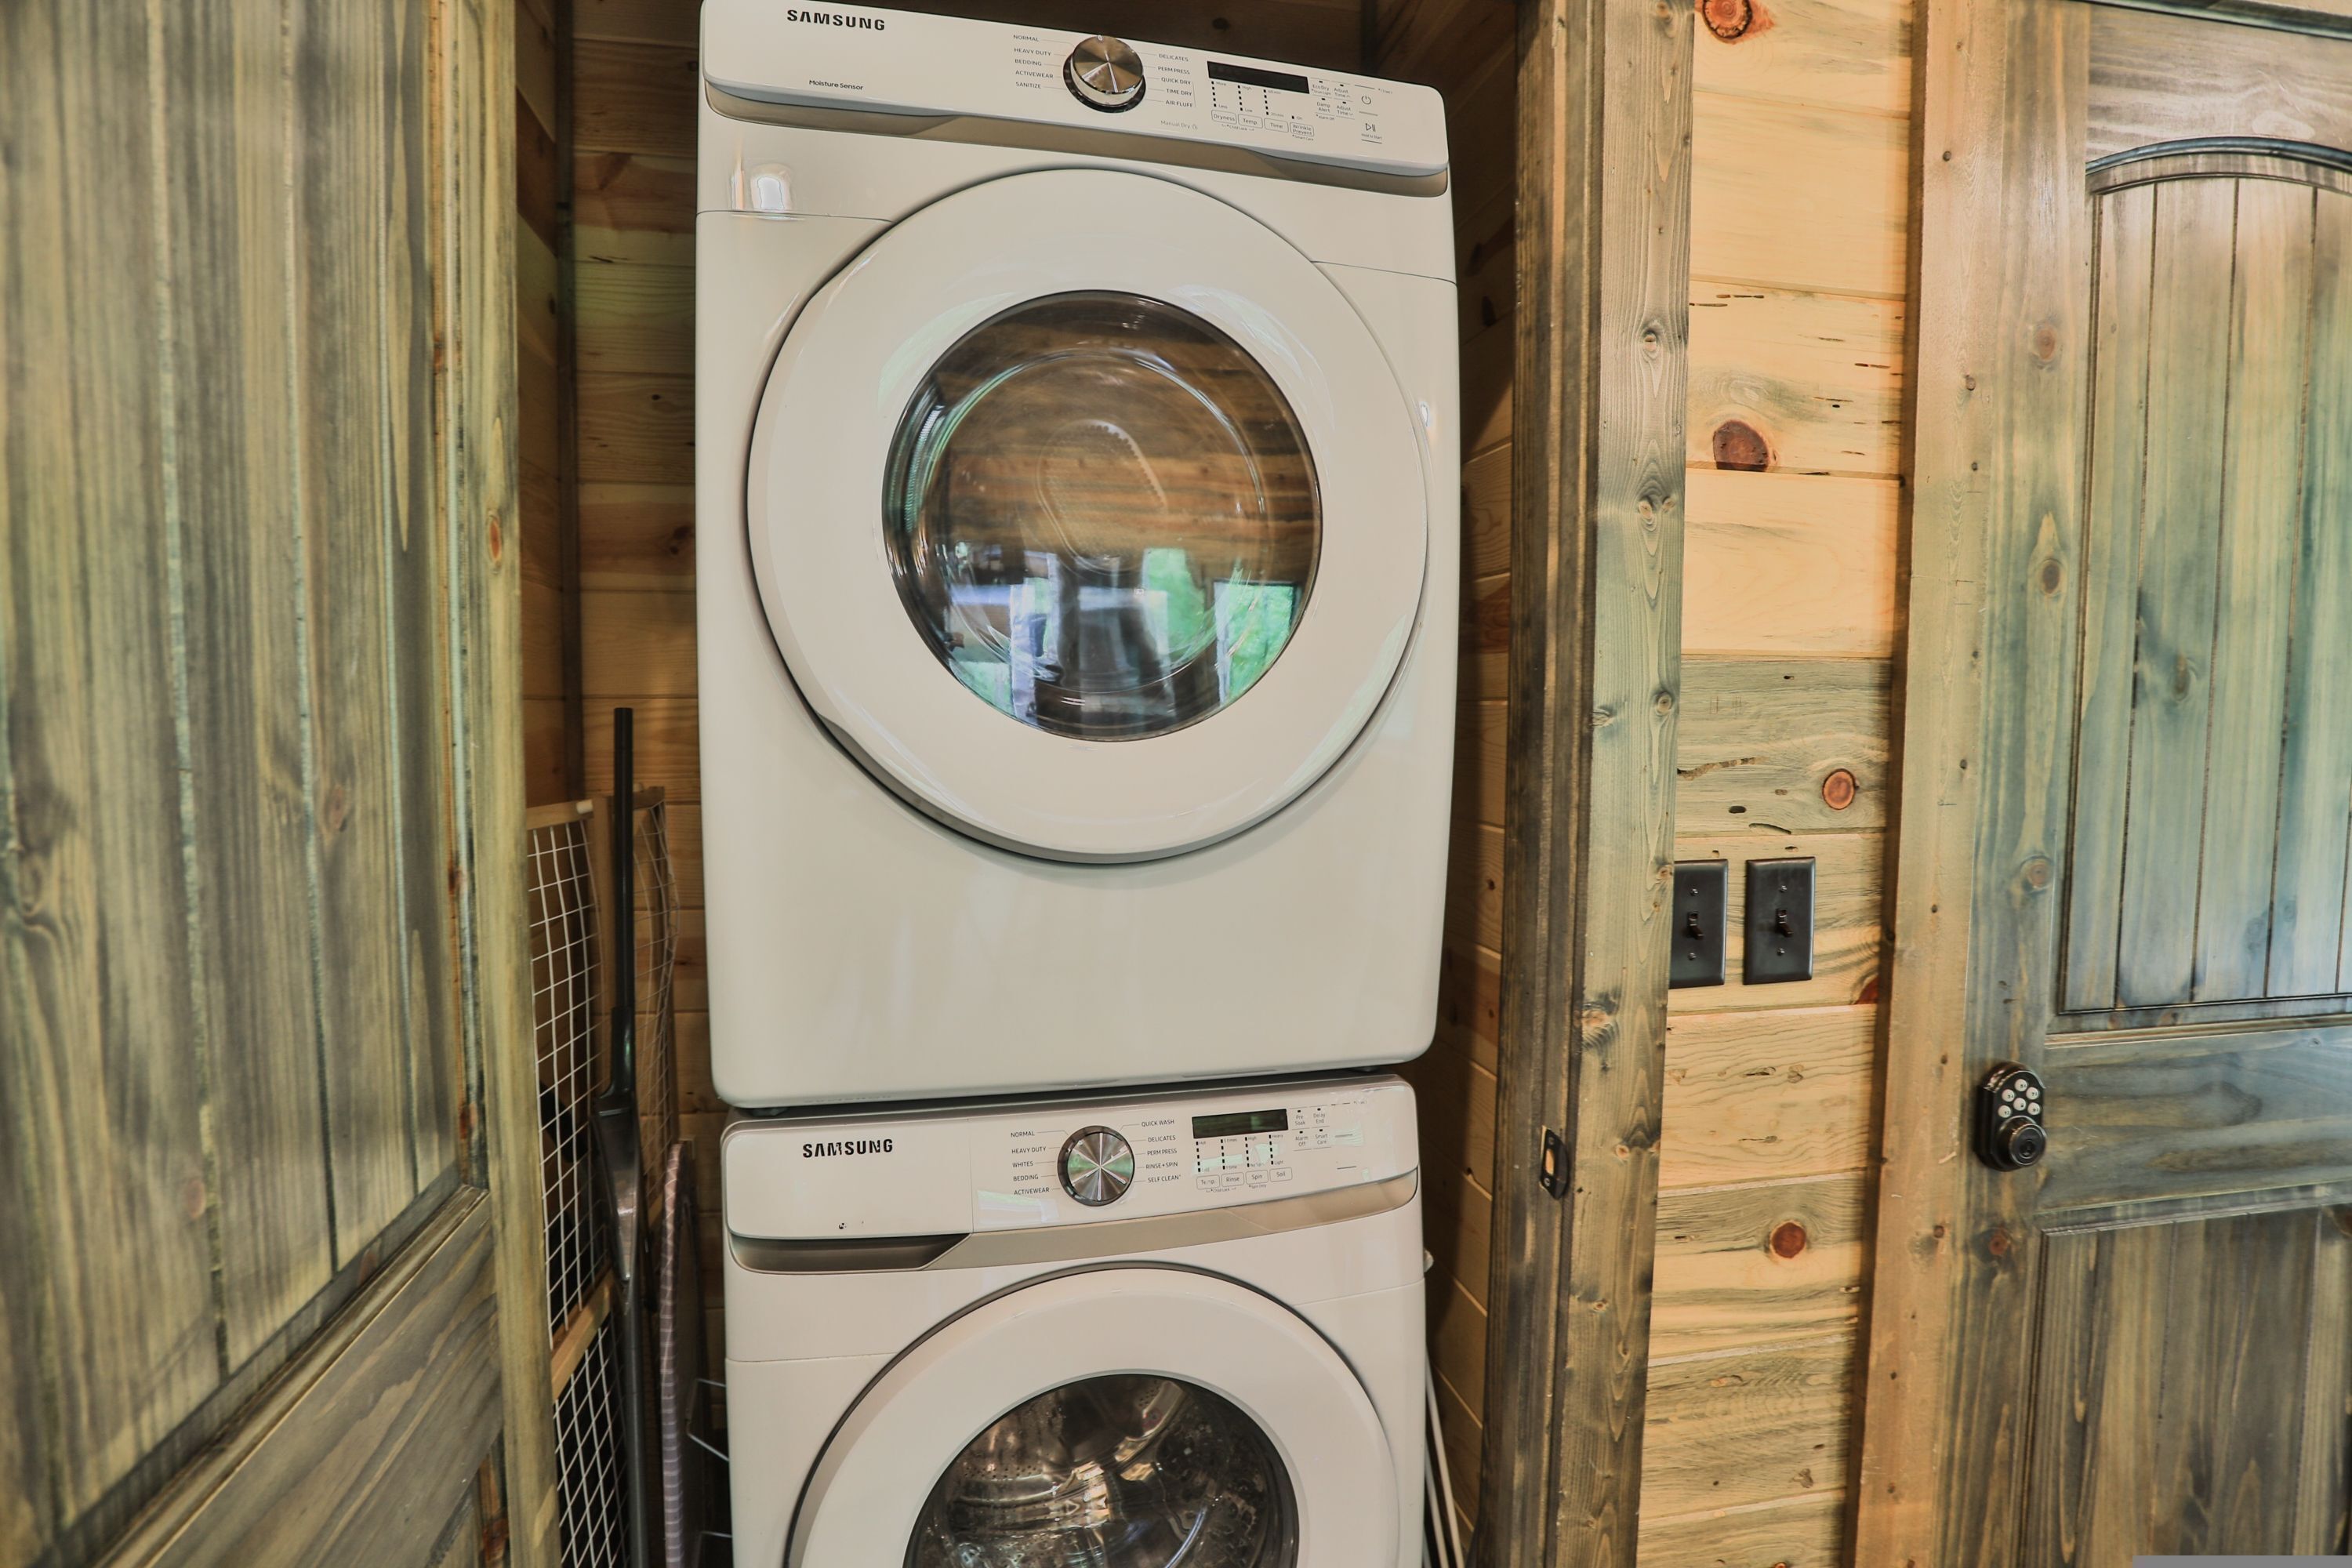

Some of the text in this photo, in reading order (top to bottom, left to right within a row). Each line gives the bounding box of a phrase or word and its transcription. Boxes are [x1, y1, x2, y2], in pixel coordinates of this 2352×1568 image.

[787, 9, 885, 31] SAMSUNG
[1159, 53, 1189, 62] DELICATES
[1015, 70, 1054, 78] ACTIVEWEAR
[809, 79, 839, 88] Moisture
[1213, 113, 1236, 122] Dryness
[803, 1138, 893, 1158] SAMSUNG
[1014, 1186, 1050, 1196] ACTIVEWEAR
